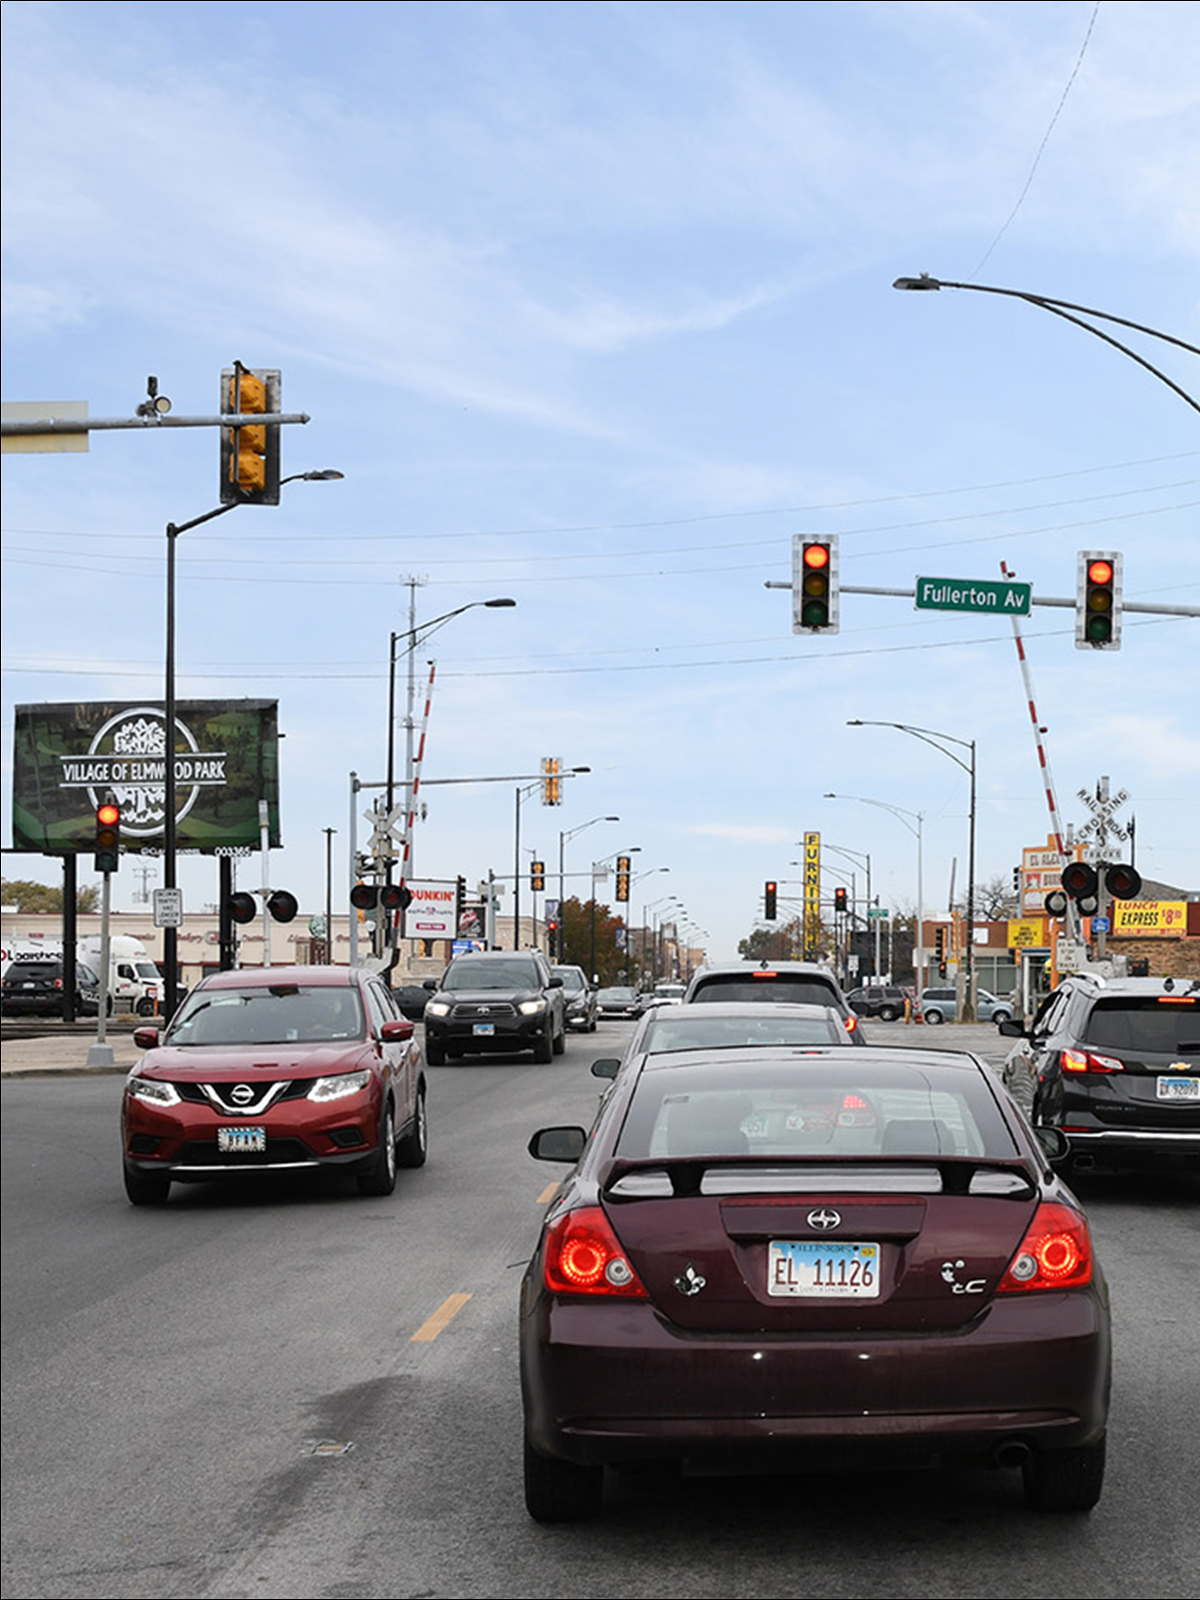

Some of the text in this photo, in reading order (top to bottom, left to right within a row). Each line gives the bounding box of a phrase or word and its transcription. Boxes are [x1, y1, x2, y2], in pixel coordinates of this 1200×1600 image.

[923, 584, 1024, 607] Fullerton Av
[63, 761, 226, 781] VILLAGE OF ELMWOD PARK
[1117, 902, 1159, 910] LUNCH
[1121, 912, 1159, 926] EXPRESS
[776, 1258, 873, 1286] EL 11126
